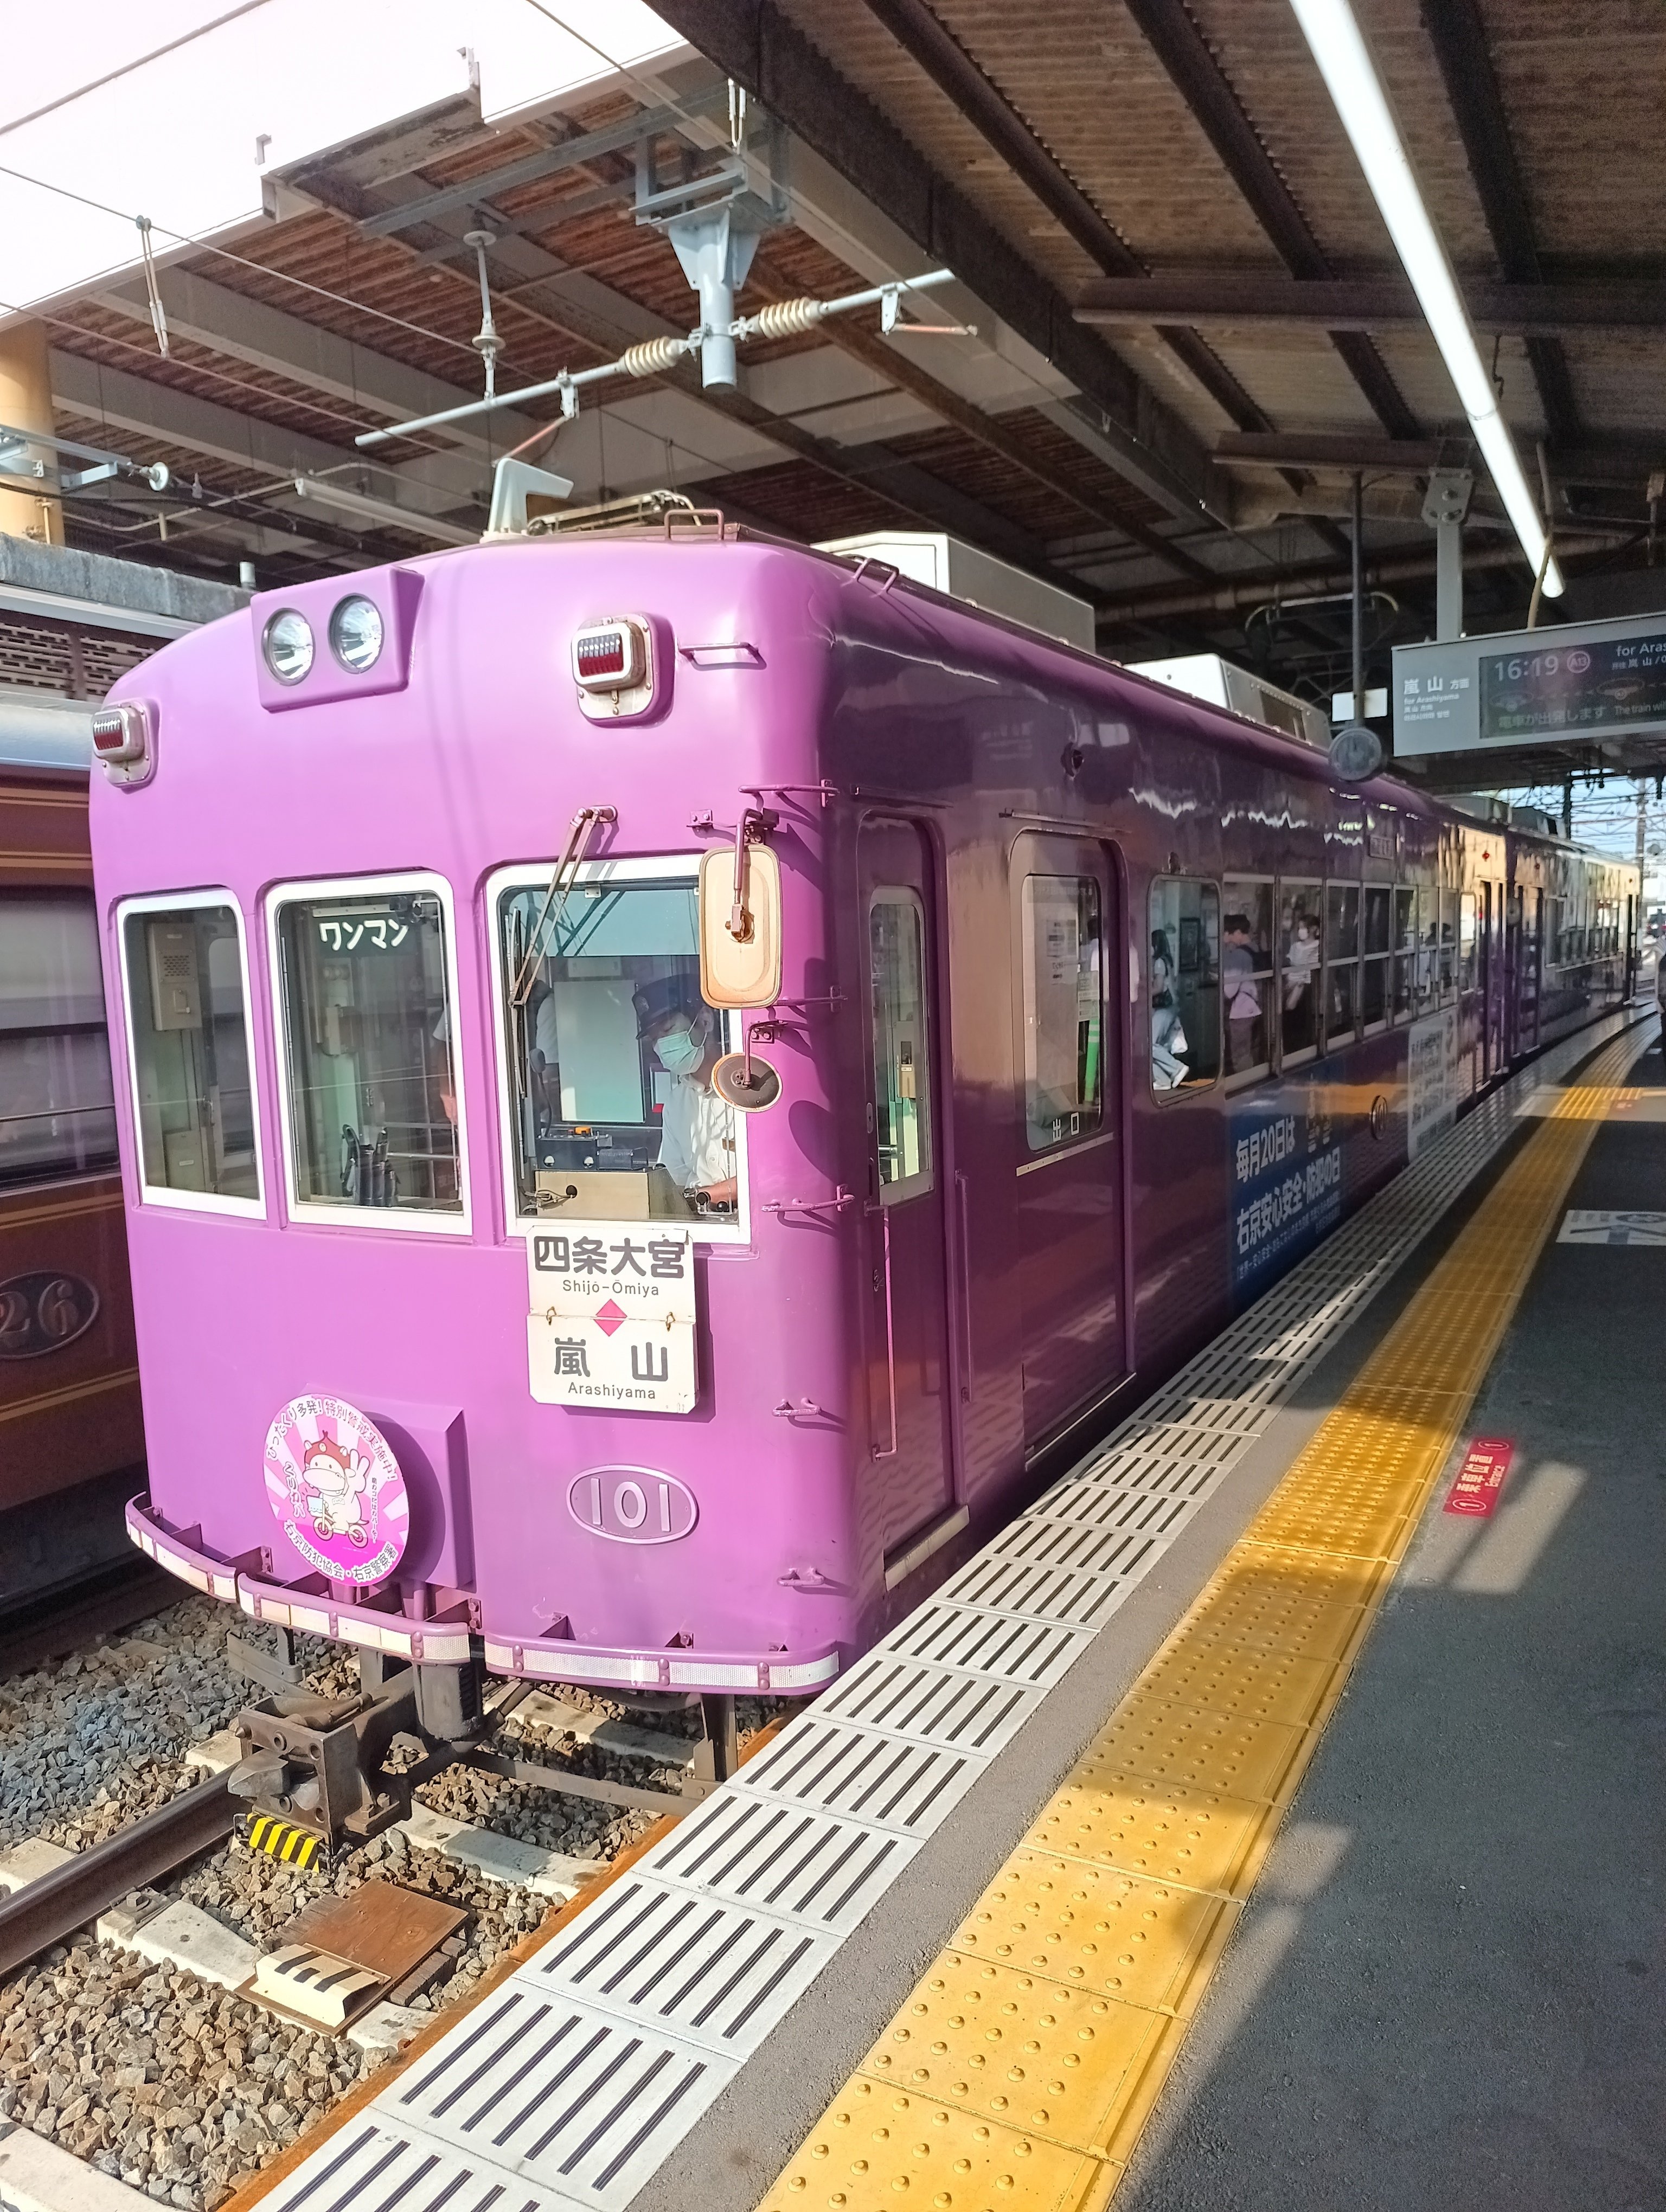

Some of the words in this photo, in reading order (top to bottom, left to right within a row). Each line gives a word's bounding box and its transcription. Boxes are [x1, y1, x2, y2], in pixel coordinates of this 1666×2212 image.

[1617, 645, 1637, 657] for
[1495, 655, 1559, 682] 16:19
[1450, 677, 1470, 690] 方面
[1416, 693, 1460, 703] Arashiyama
[319, 918, 408, 951] ワンマン
[1236, 1115, 1295, 1183] 毎月20日は
[534, 1235, 685, 1279] 四条大宮
[568, 1382, 656, 1399] Arashiyama
[1456, 1454, 1494, 1493] 乗車位置
[1484, 1465, 1505, 1488] Entrance
[590, 1477, 671, 1532] 101
